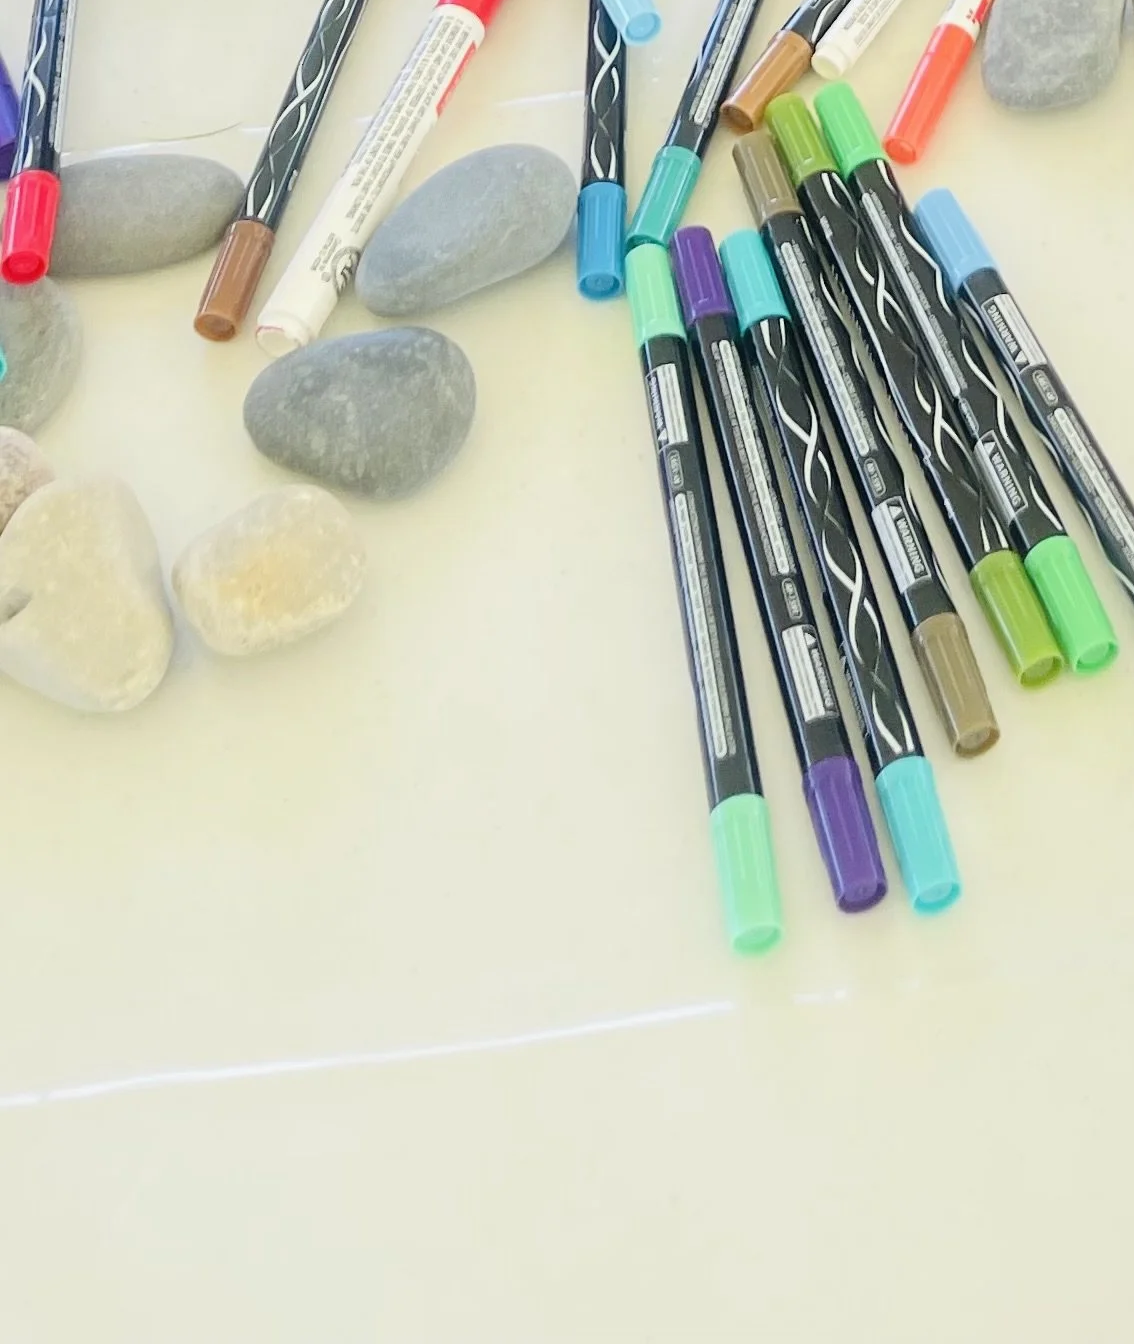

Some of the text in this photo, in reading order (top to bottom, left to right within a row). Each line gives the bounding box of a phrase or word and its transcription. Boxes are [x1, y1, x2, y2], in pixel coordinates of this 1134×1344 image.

[987, 304, 1019, 354] WARNING
[991, 451, 1022, 508] WARNING
[896, 516, 926, 575] WARNING
